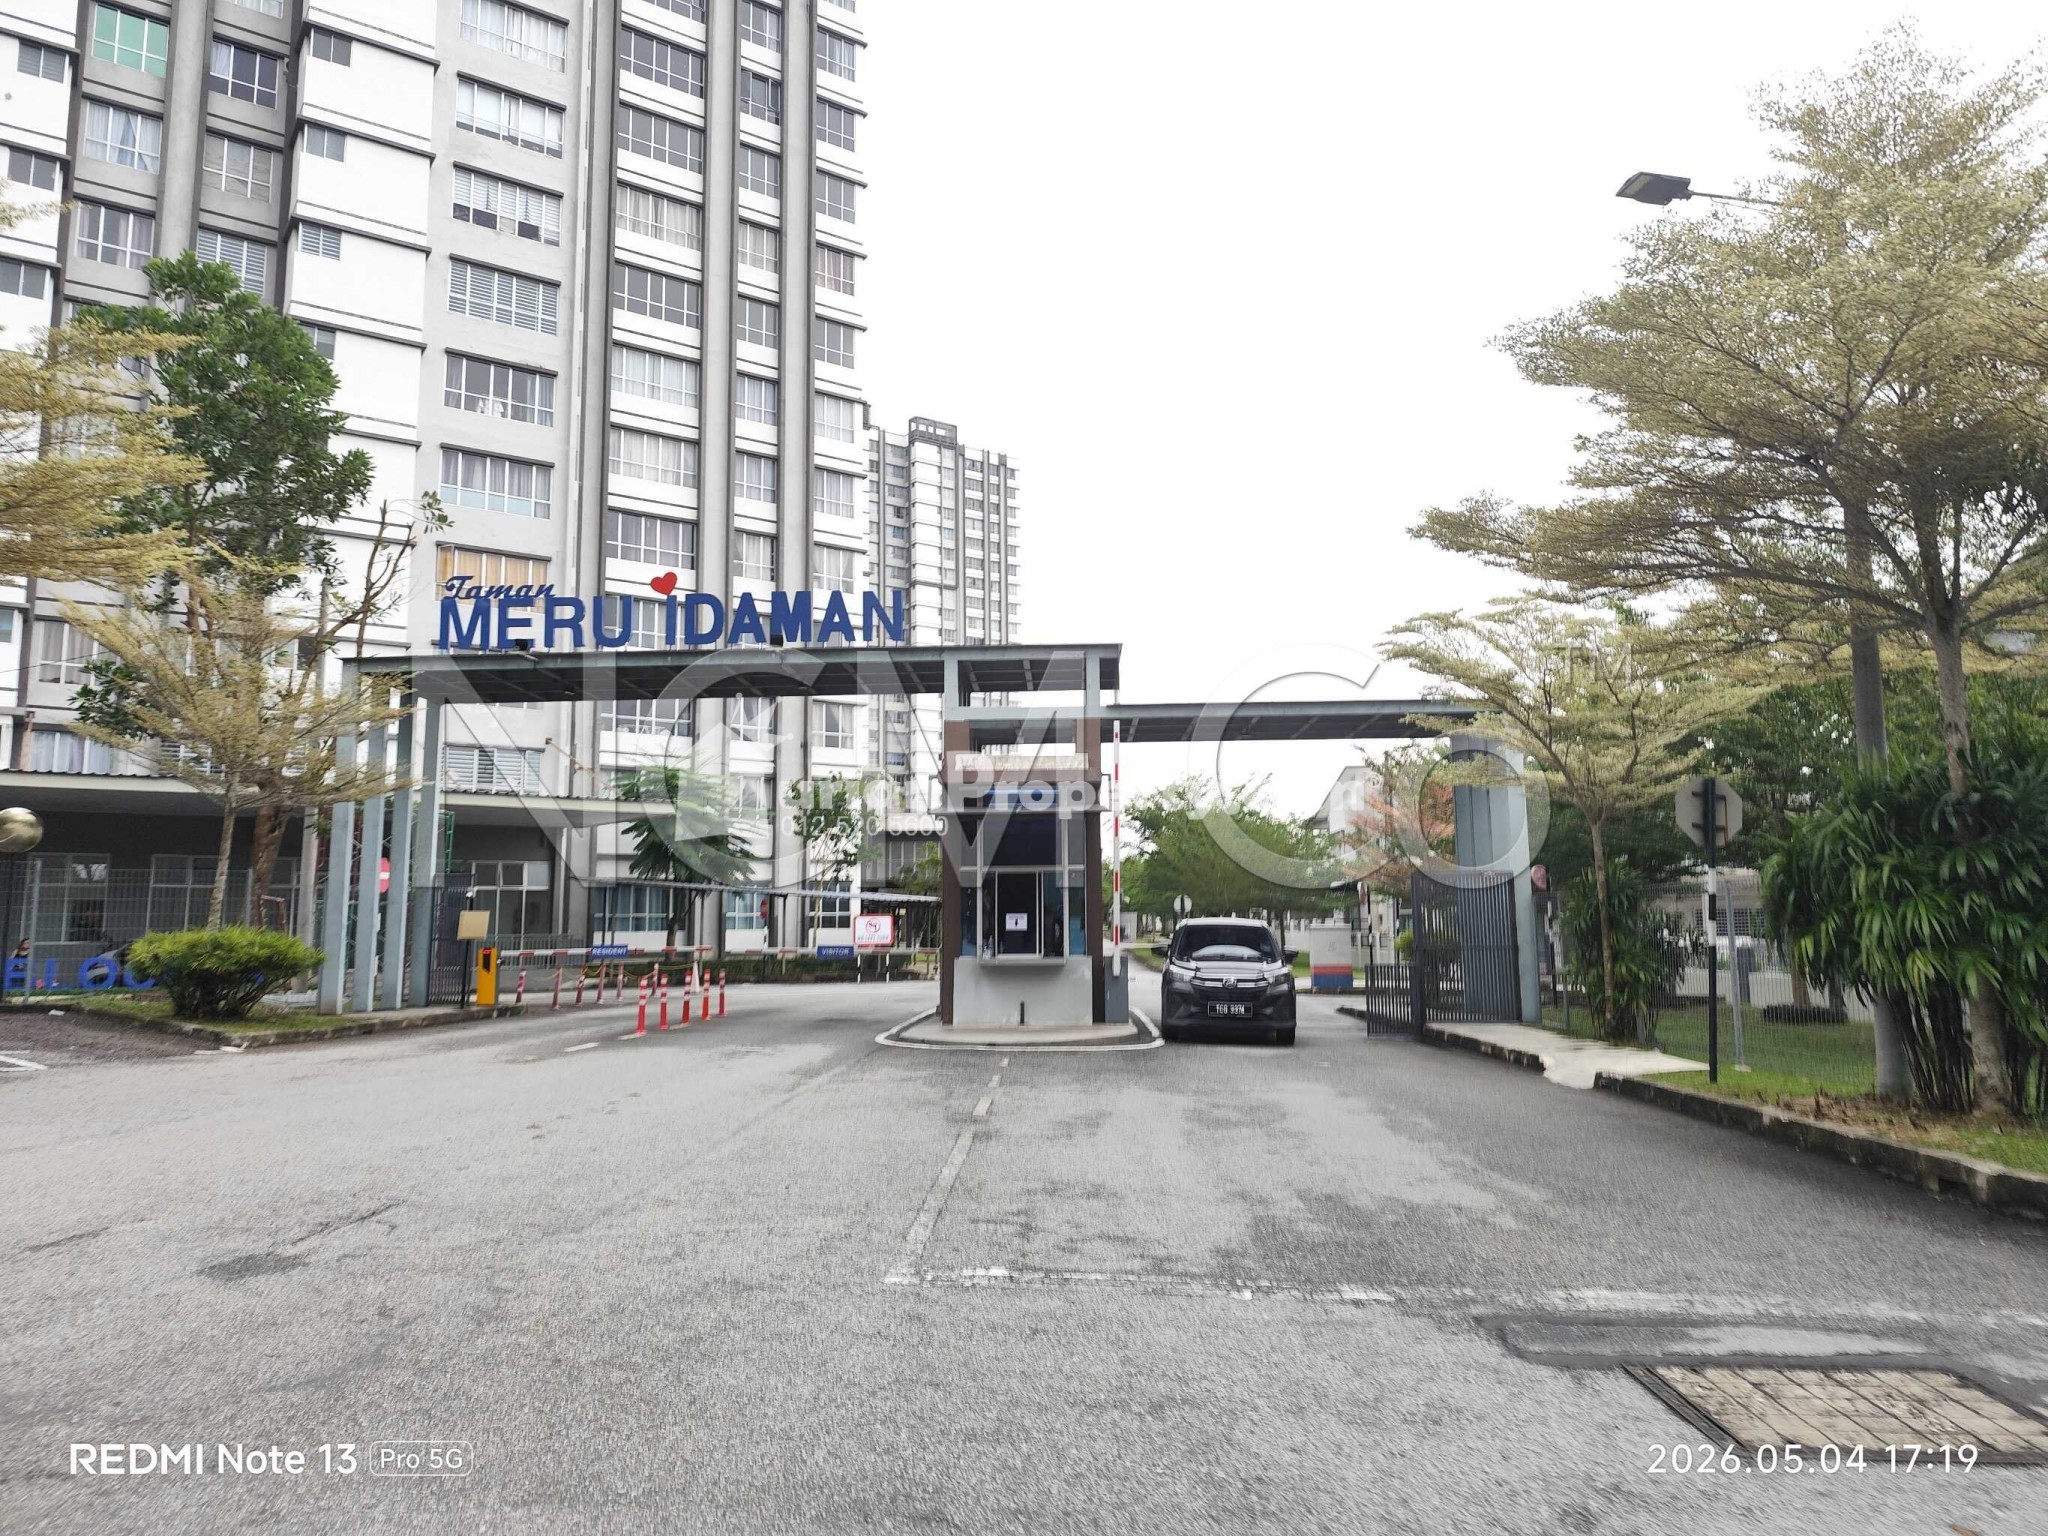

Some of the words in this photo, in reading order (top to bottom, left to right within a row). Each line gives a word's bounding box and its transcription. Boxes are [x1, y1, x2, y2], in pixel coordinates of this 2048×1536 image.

[446, 575, 556, 600] Taman
[439, 595, 632, 650] MERU
[592, 946, 628, 957] RESIDENT
[821, 947, 850, 957] VISITOR
